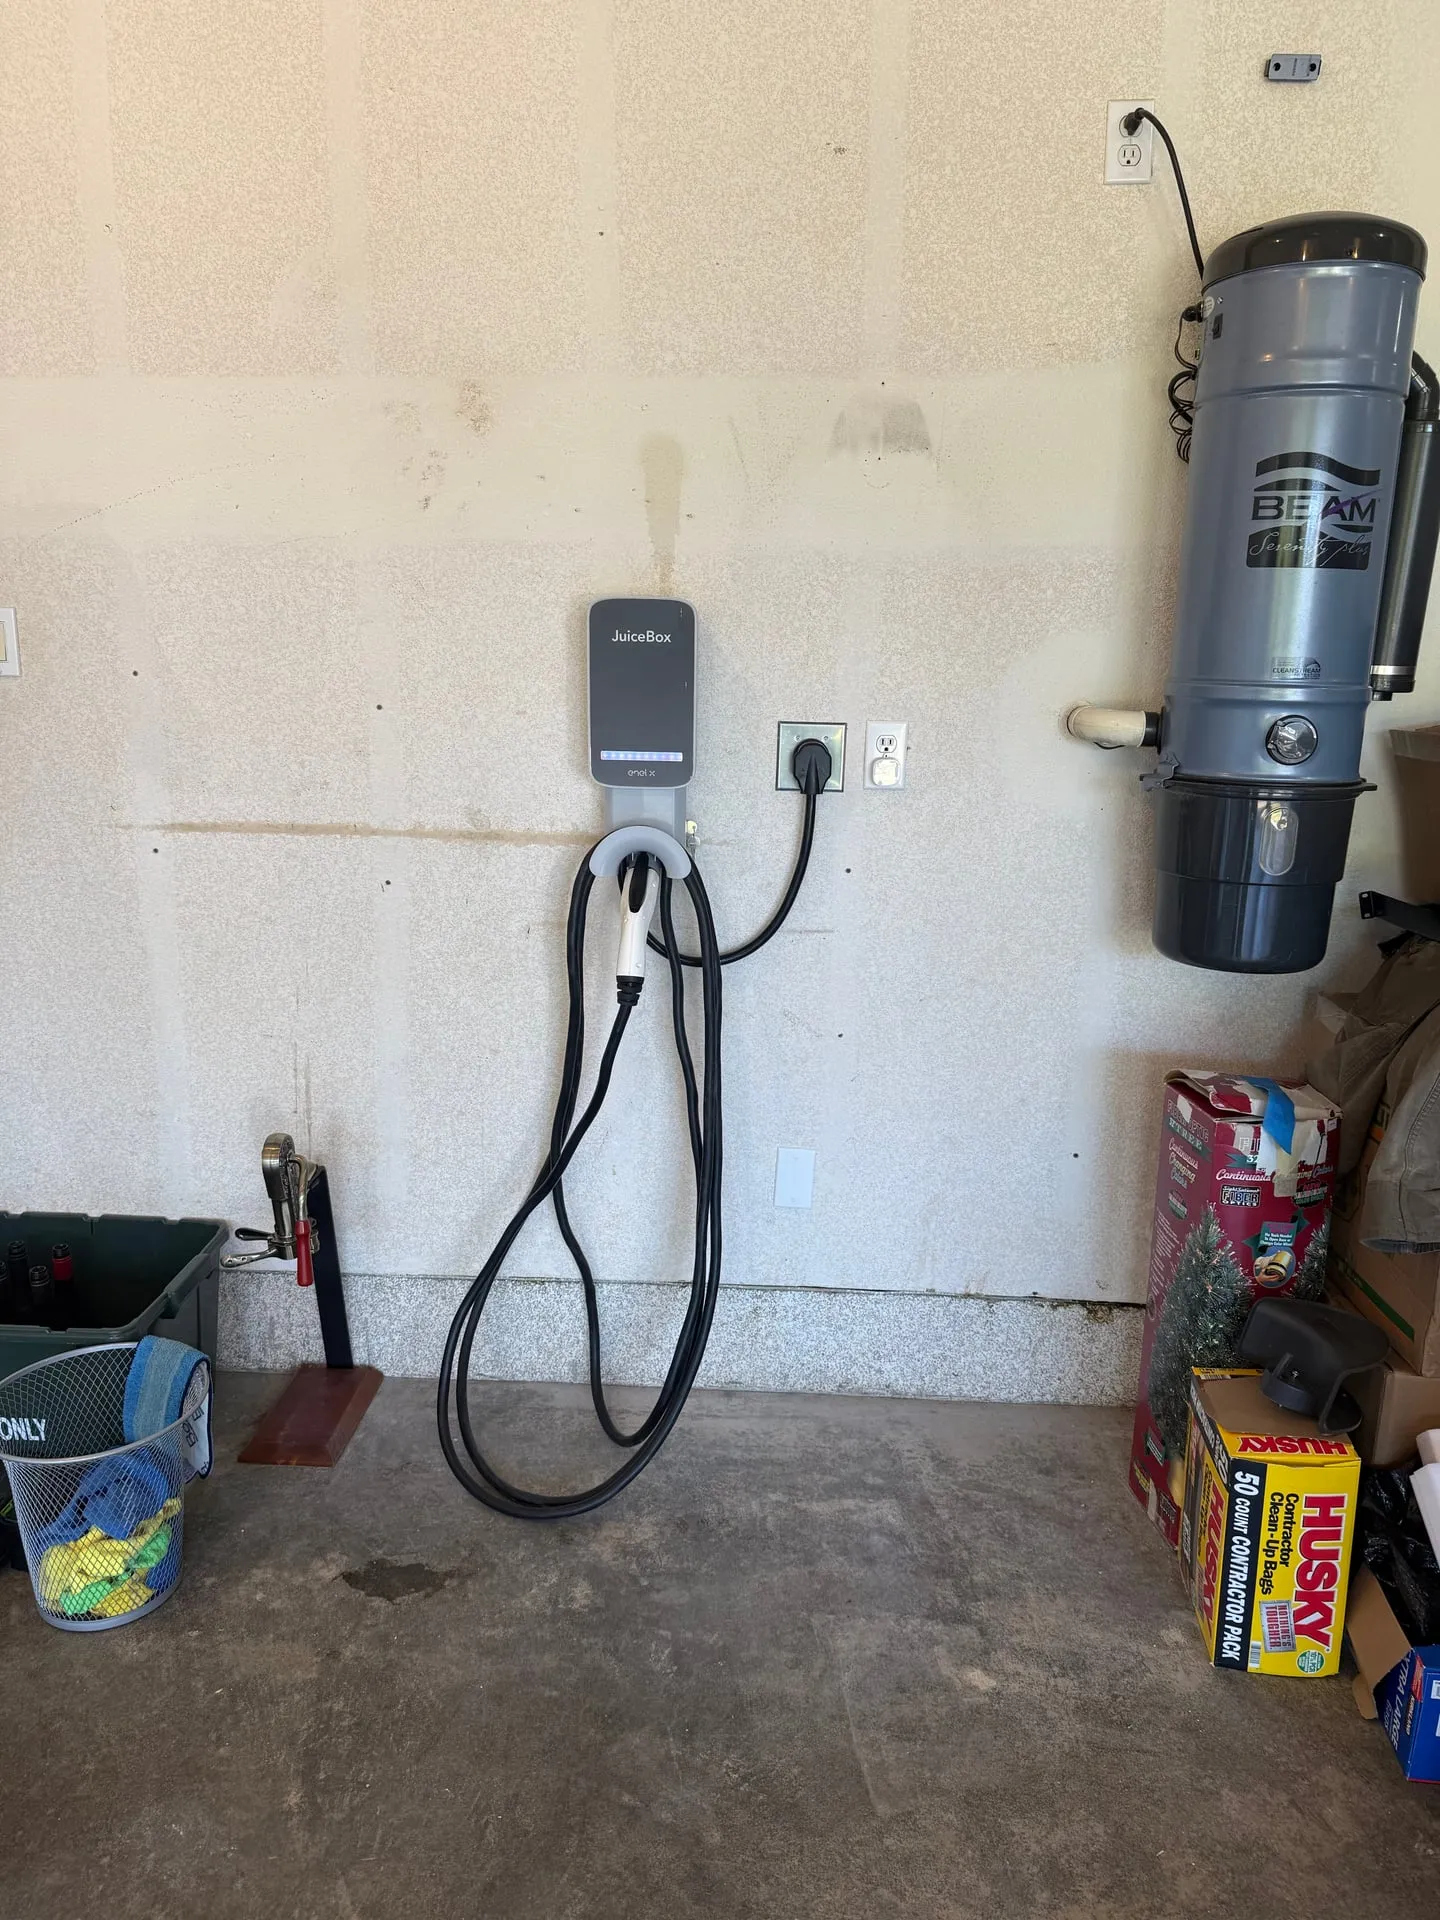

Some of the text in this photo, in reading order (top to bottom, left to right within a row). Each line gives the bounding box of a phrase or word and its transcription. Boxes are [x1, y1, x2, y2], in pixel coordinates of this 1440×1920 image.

[1252, 495, 1377, 522] BEAM
[611, 630, 672, 643] JuiceBox
[627, 768, 647, 777] enel
[1221, 1190, 1259, 1202] FIBER
[0, 1416, 46, 1441] ONLY
[1238, 1436, 1349, 1456] HUSKY
[1259, 1491, 1284, 1595] Clean-Up Bags
[1280, 1493, 1299, 1567] Contractor
[1203, 1480, 1224, 1638] HUSKY
[1221, 1471, 1260, 1661] 50 COUNT CONTRACTOR PACK
[1293, 1494, 1347, 1648] HUSKY
[1278, 1605, 1291, 1647] NOTHING'S
[1391, 1694, 1404, 1751] LARGE
